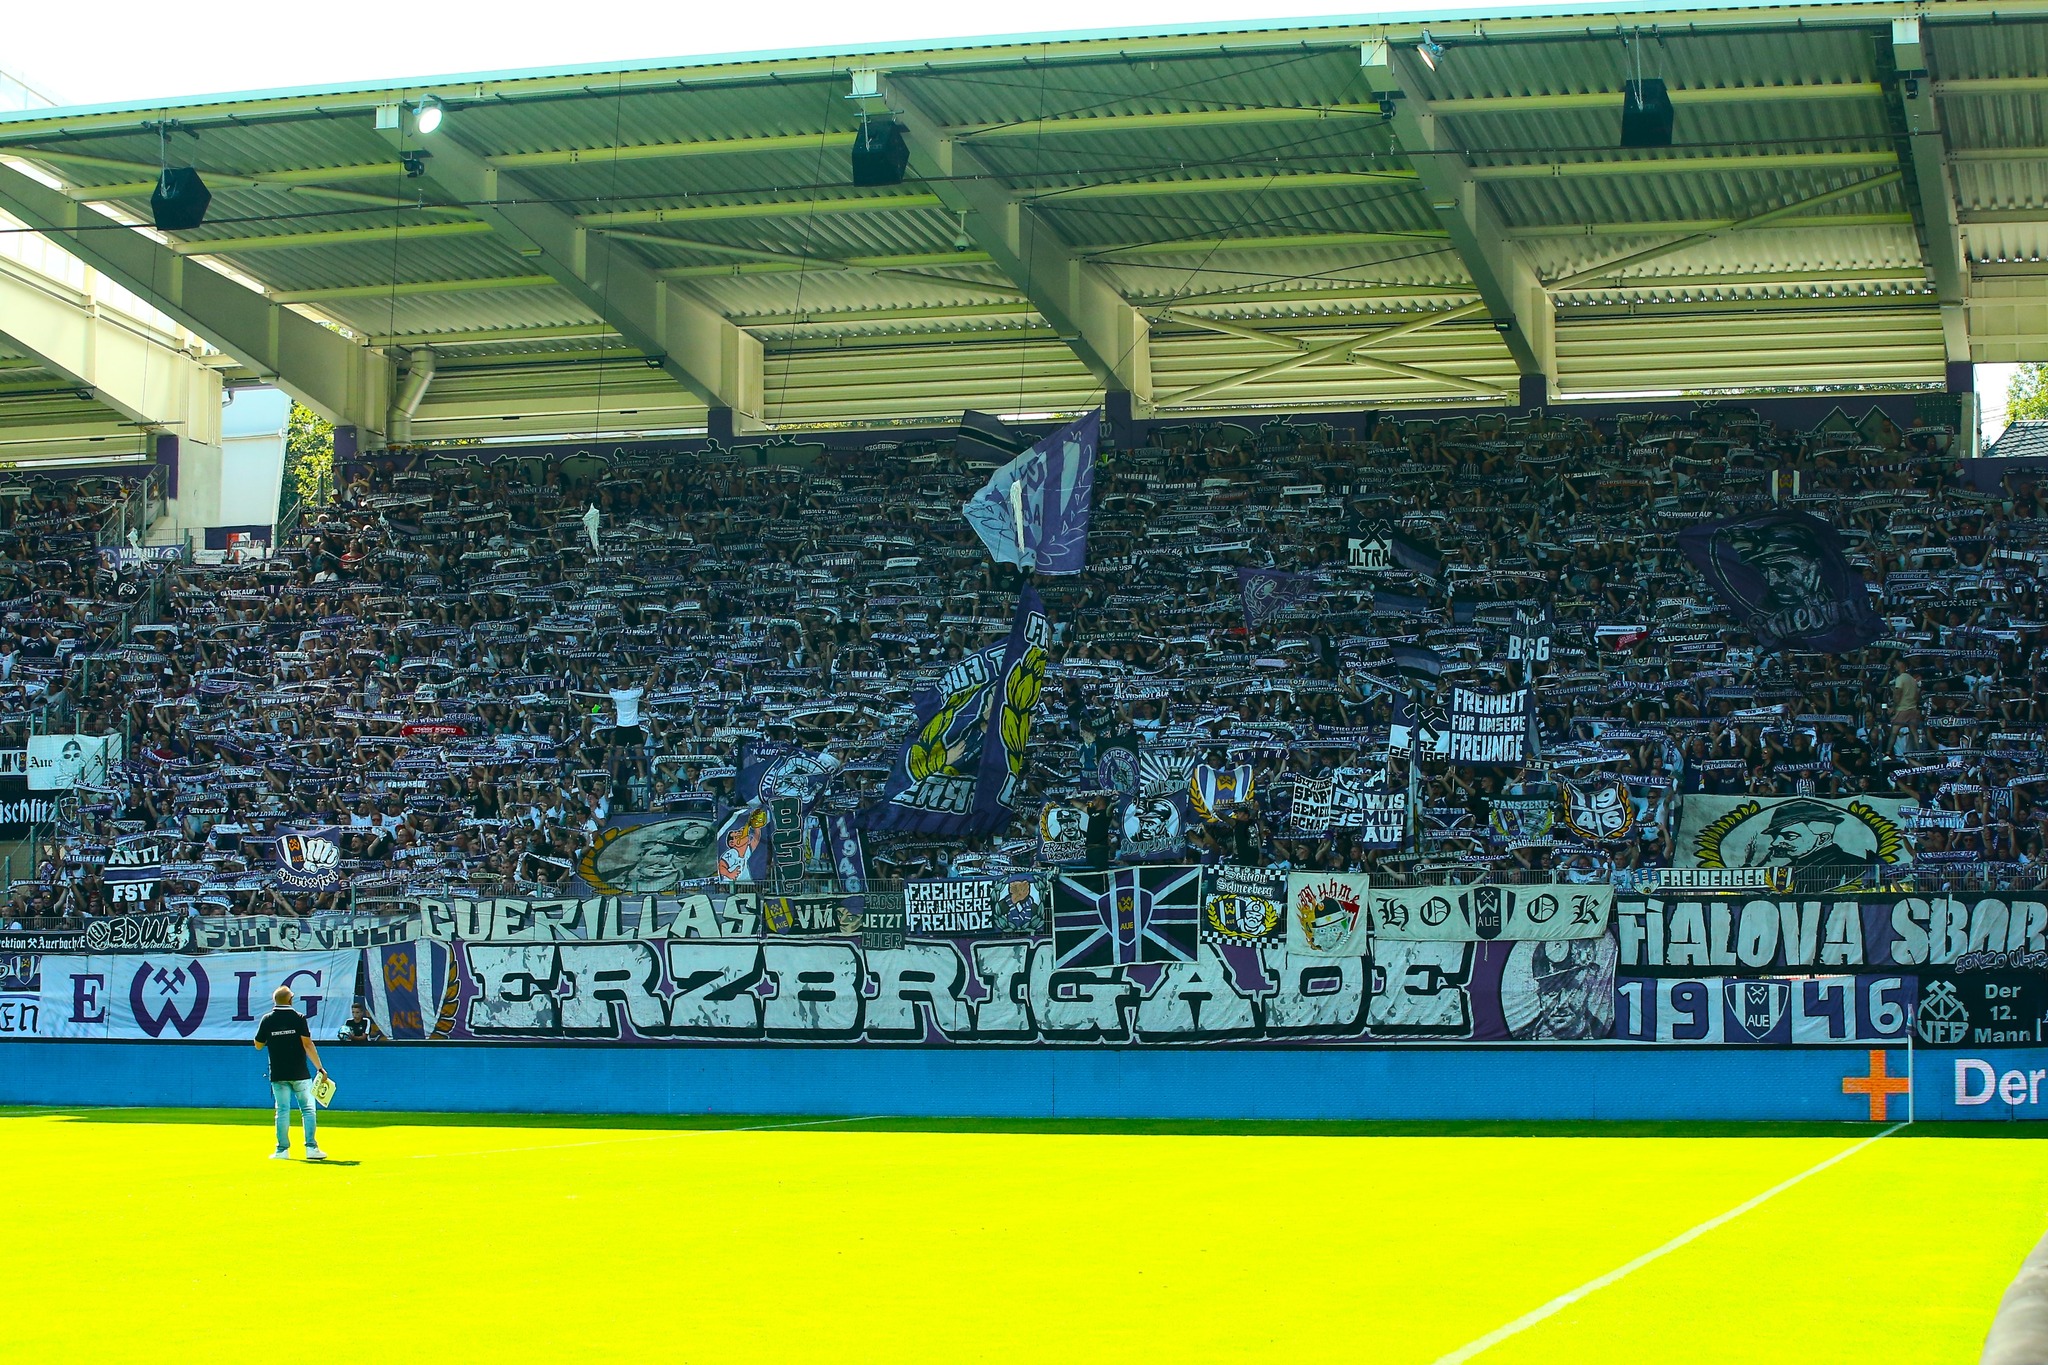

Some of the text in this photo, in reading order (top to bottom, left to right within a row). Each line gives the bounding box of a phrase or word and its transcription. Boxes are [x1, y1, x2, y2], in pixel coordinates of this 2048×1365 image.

[1349, 549, 1393, 567] ULTRA
[1507, 634, 1550, 661] BSG
[1453, 687, 1528, 714] FREIHEIT
[1452, 714, 1526, 733] FÜR UNSERE
[1450, 734, 1525, 763] FREUNDE
[29, 756, 53, 768] Aue
[1909, 763, 1945, 773] WISMUT
[1364, 793, 1405, 809] WIS
[1494, 800, 1550, 809] FANSZENE
[0, 799, 56, 823] schlitz
[1362, 810, 1404, 826] MUT
[1362, 826, 1403, 842] AUE
[107, 849, 160, 865] ANTI
[291, 855, 305, 863] AUE
[277, 869, 339, 892] sport frei
[1224, 869, 1268, 883] Sektion
[1661, 870, 1765, 886] FREIBERGER
[112, 882, 153, 903] FSV
[908, 880, 993, 901] FREIHEIT
[1215, 878, 1276, 897] Schneeberg
[863, 893, 902, 910] PROST
[938, 897, 992, 914] UNSERE
[421, 893, 757, 940] GUERILLAS
[774, 920, 789, 928] AUE
[862, 913, 902, 928] JETZT
[910, 910, 993, 932] FREUNDE
[1477, 916, 1499, 927] AUE
[108, 917, 169, 944] EDW
[1120, 922, 1133, 930] AUE
[861, 932, 902, 949] HIER
[466, 940, 1475, 1040] ERZBRIGADE
[1985, 984, 2021, 999] Der
[391, 1010, 422, 1029] AUE
[1746, 1014, 1770, 1028] AUE
[1990, 1005, 2017, 1020] 12.
[1974, 1028, 2031, 1043] Mann
[1954, 1058, 2046, 1106] Der
